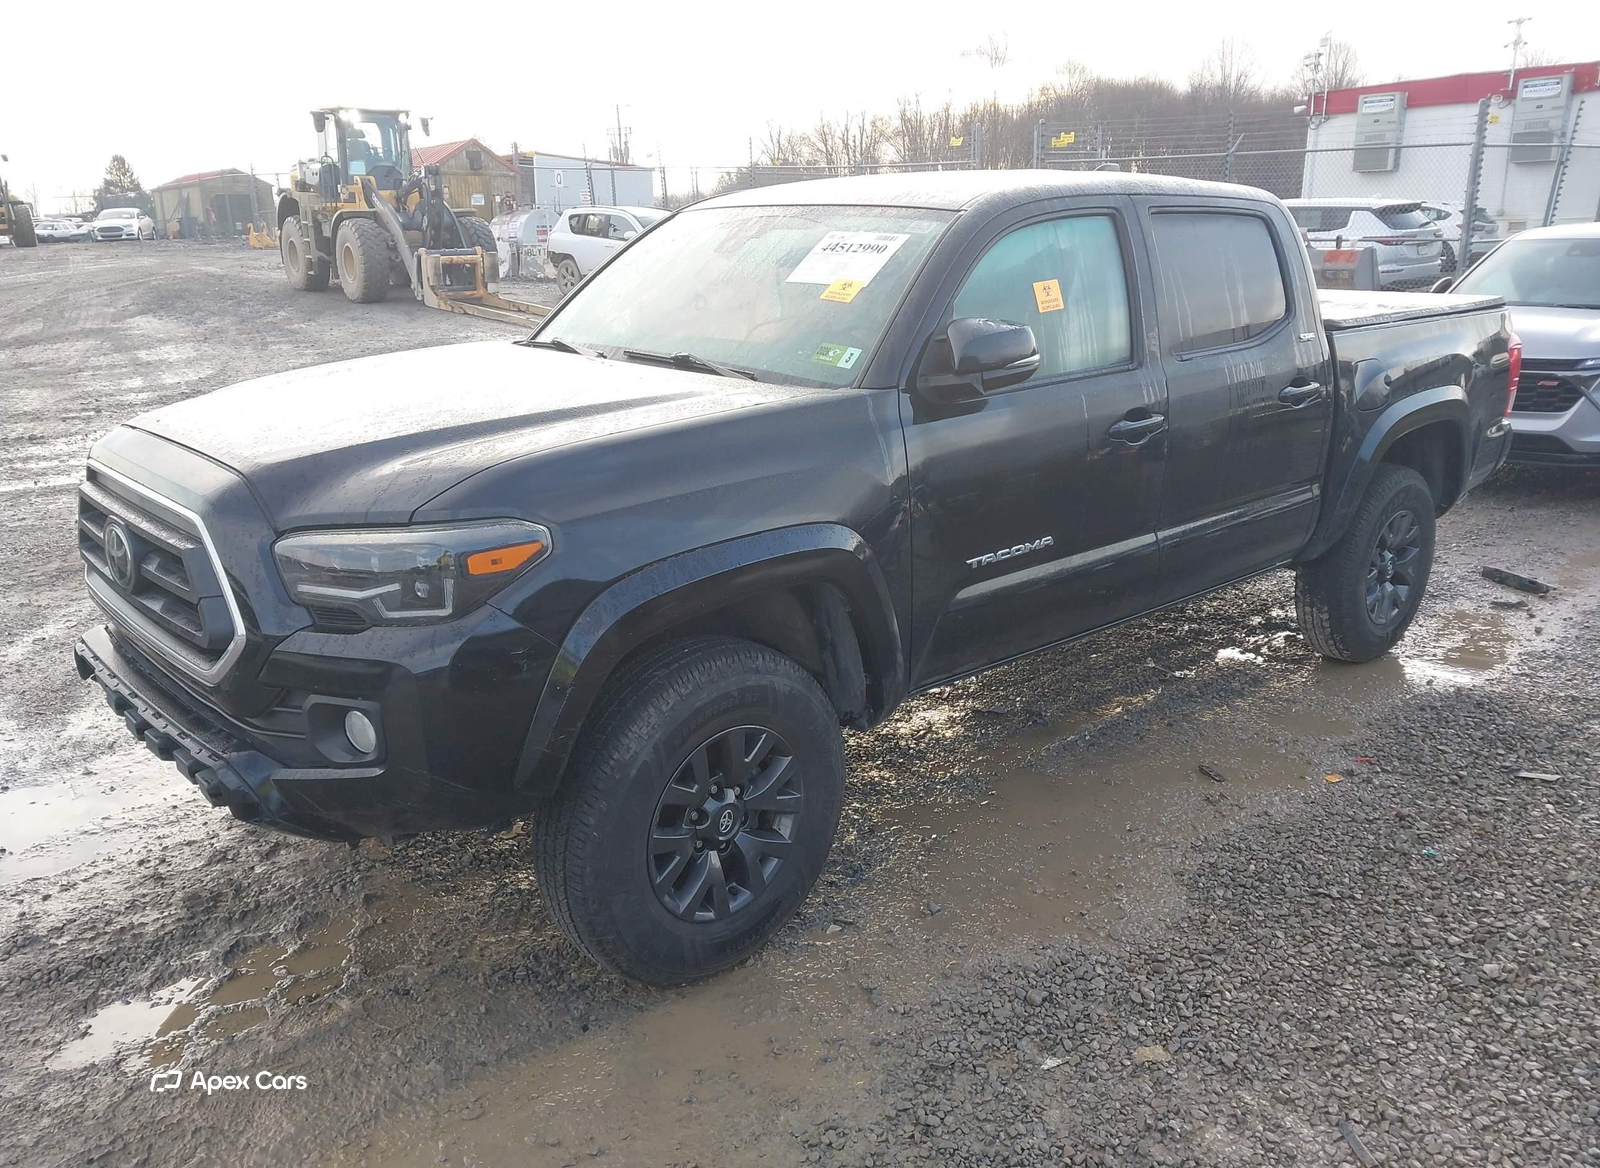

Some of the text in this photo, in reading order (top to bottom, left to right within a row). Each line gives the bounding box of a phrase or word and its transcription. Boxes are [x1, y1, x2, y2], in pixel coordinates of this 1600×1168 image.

[1525, 86, 1560, 94] VANGUARD
[821, 242, 888, 254] 44512990
[844, 352, 855, 364] 3
[965, 536, 1054, 569] TACOMA
